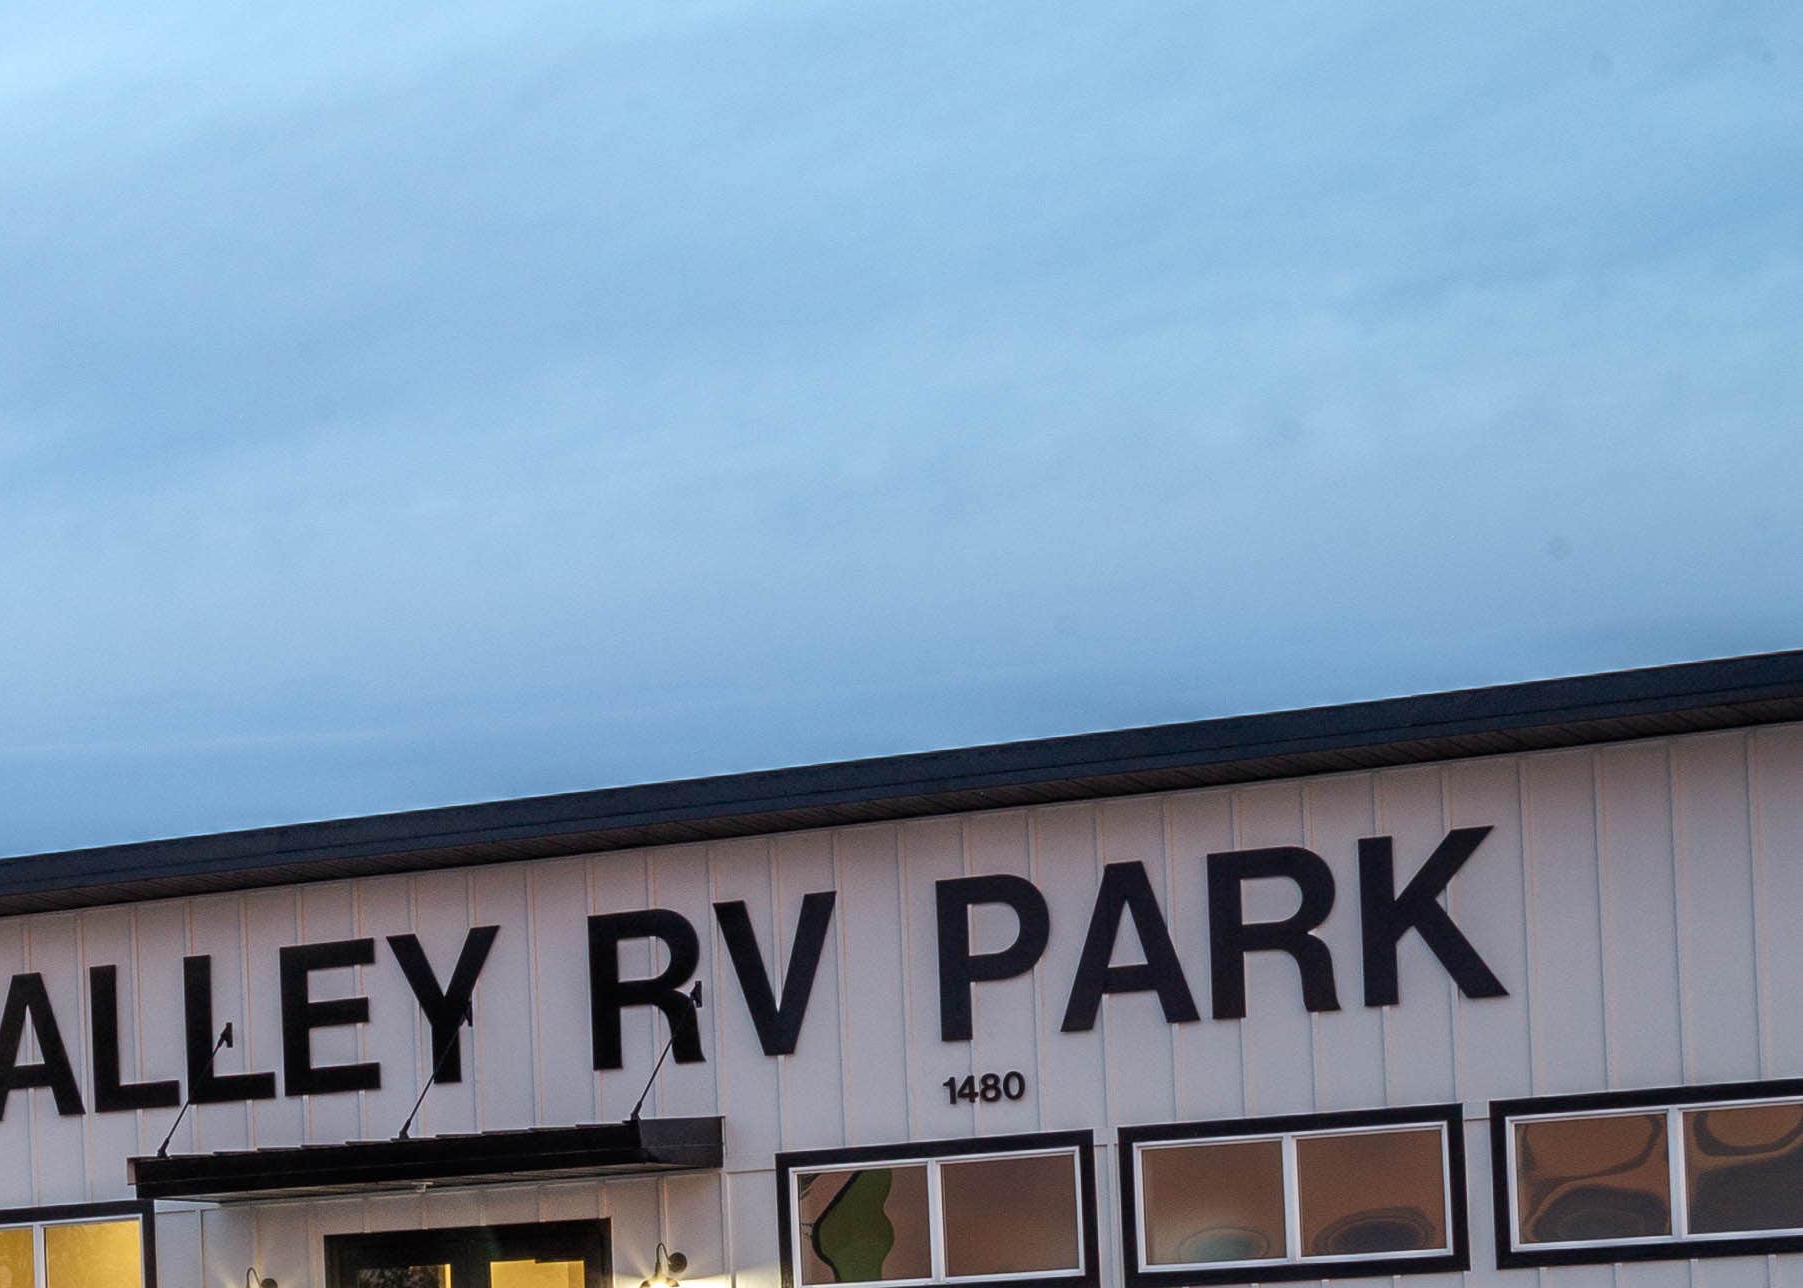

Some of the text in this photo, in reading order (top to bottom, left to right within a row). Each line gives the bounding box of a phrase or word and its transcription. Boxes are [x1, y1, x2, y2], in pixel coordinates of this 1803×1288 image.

[586, 890, 837, 1071] RV
[934, 825, 1510, 1043] PARK
[942, 1070, 1026, 1105] 1480
